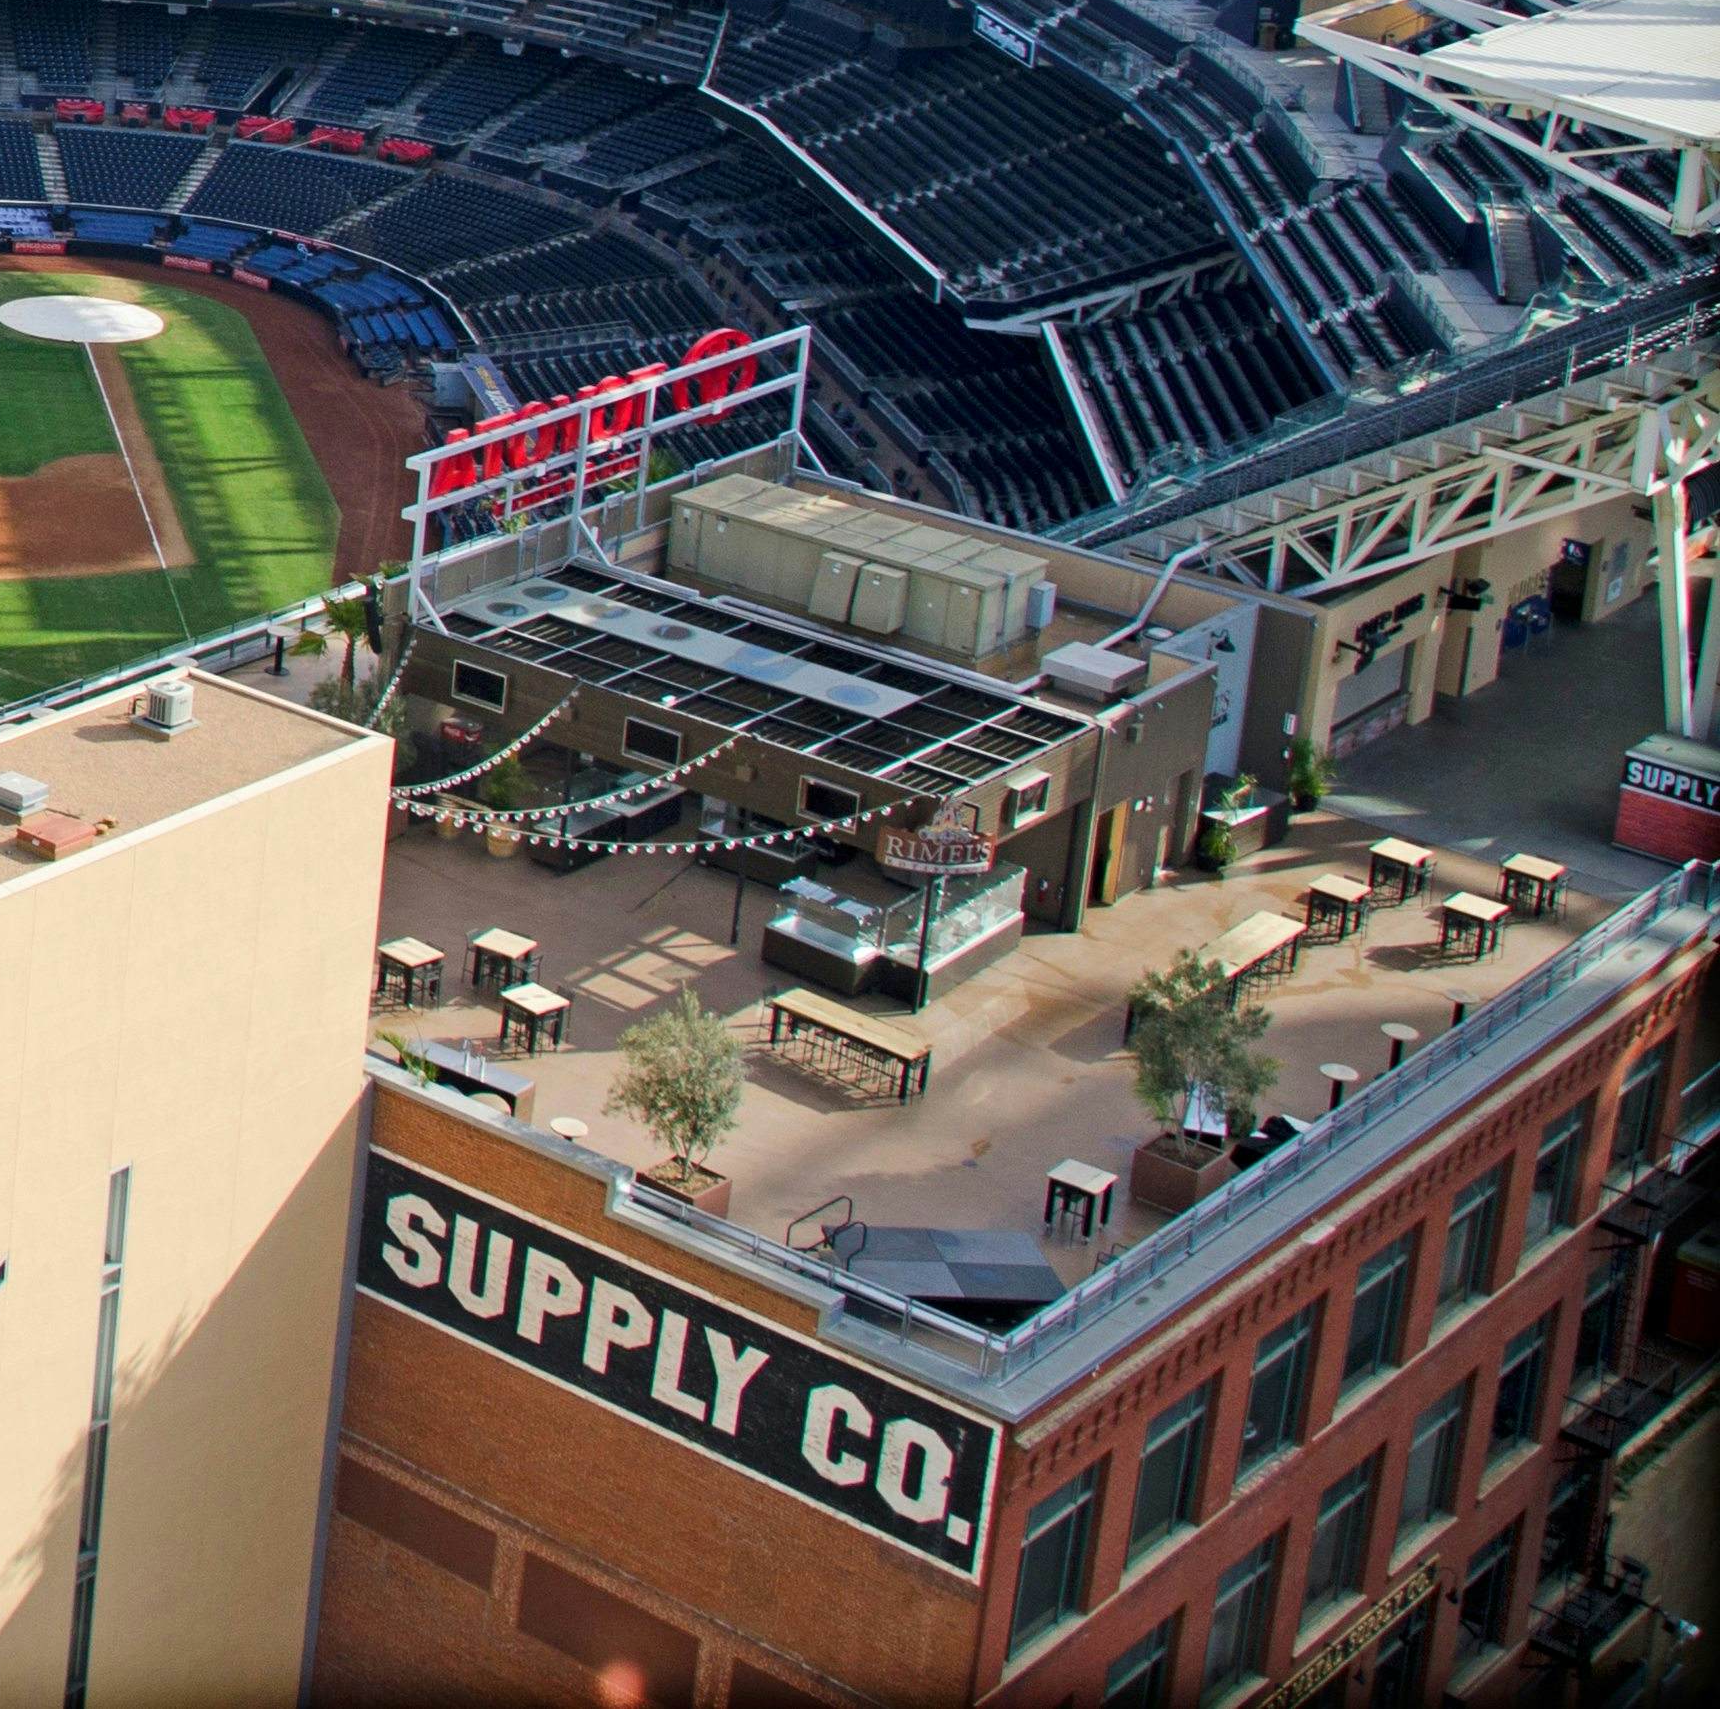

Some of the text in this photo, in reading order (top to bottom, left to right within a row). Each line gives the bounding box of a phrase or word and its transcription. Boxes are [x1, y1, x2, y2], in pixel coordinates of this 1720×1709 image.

[1627, 760, 1720, 806] SUPPLY
[381, 1191, 972, 1546] SUPPLY CO.
